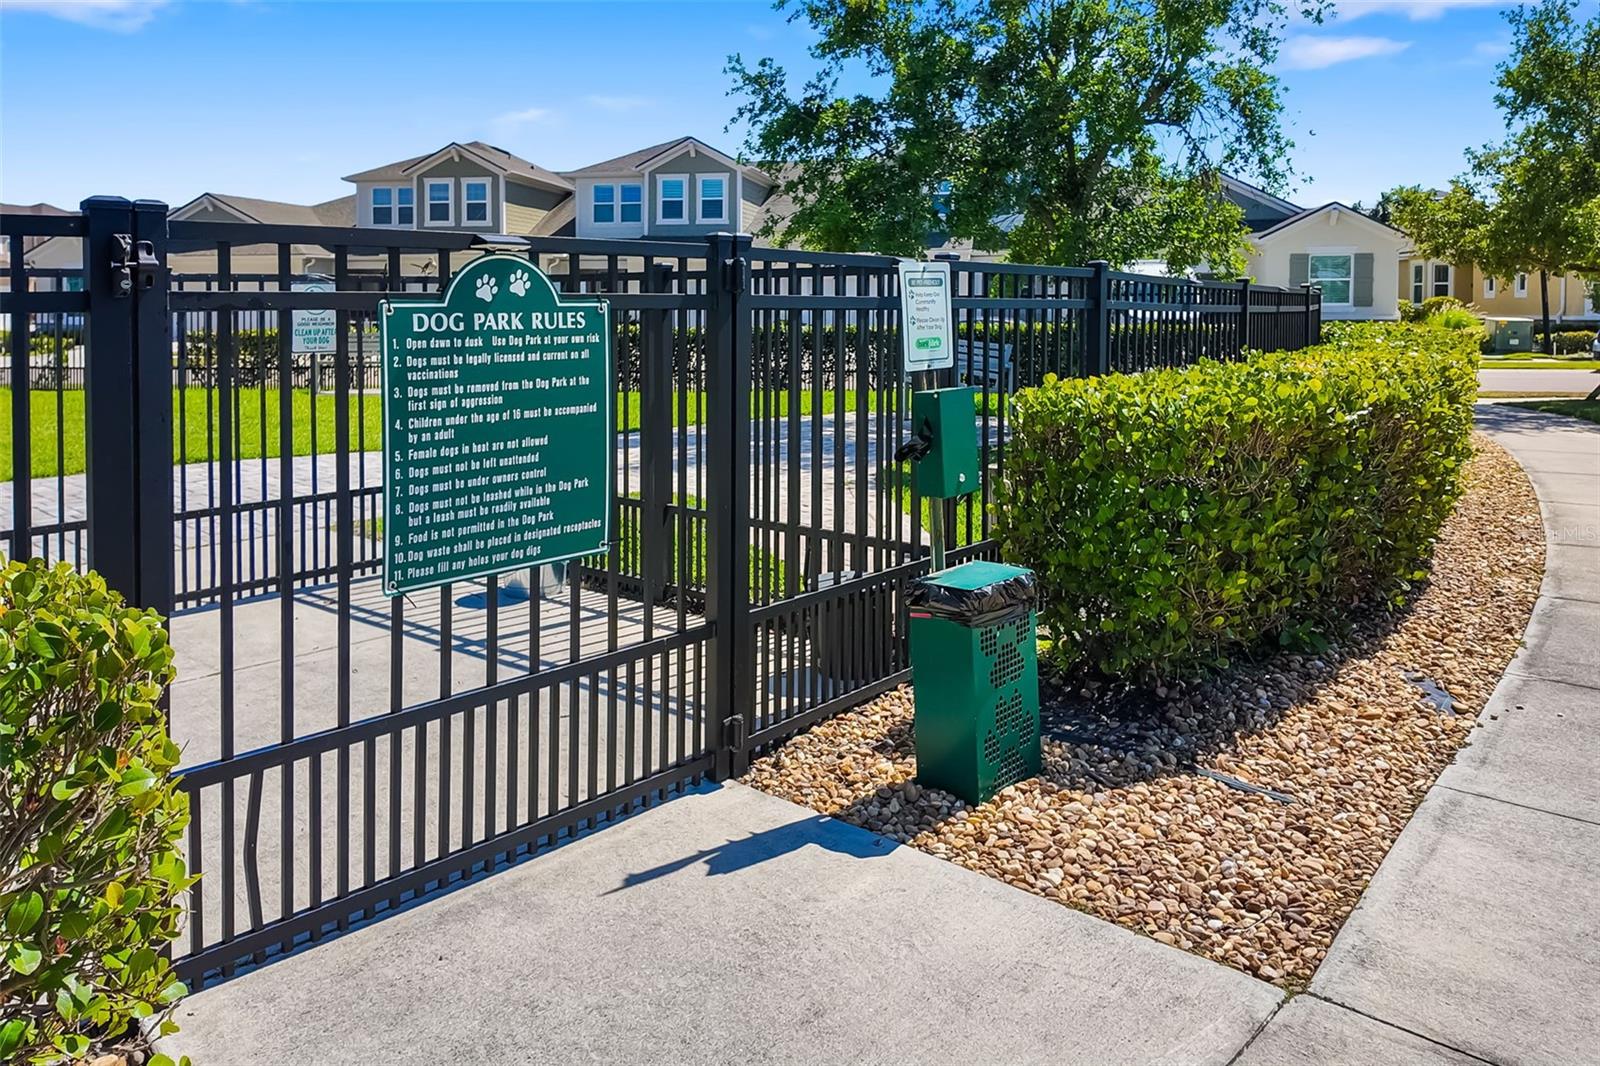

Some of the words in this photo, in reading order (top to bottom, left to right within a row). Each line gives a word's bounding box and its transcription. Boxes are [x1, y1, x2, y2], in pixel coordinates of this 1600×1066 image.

[322, 328, 336, 336] AFTE
[412, 312, 465, 332] DOG
[473, 312, 524, 330] PARK
[532, 312, 586, 329] RULES
[393, 338, 399, 350] 1.
[406, 338, 427, 350] Open
[430, 338, 450, 349] dawn
[454, 337, 462, 348] to
[465, 336, 483, 347] dusk
[492, 336, 506, 346] Use
[509, 335, 522, 347] Dog
[525, 334, 541, 345] Park
[544, 334, 552, 344] at
[553, 335, 568, 345] your
[571, 335, 584, 343] own
[587, 333, 600, 343] risk
[393, 356, 401, 367] 2.
[407, 356, 427, 368] Dogs
[430, 355, 450, 366] must
[454, 354, 463, 365] be
[466, 353, 491, 365] legally
[494, 352, 525, 363] licensed
[528, 351, 540, 361] and
[543, 350, 568, 360] current
[571, 351, 578, 359] on
[581, 349, 589, 359] all
[394, 388, 402, 398] 3.
[407, 386, 428, 398] Dogs
[432, 385, 451, 396] must
[454, 383, 464, 394] be
[467, 381, 499, 392] removed
[502, 380, 519, 391] from
[522, 379, 533, 390] the
[536, 378, 549, 390] Dog
[552, 377, 567, 387] Park
[570, 376, 576, 386] at
[579, 376, 589, 385] the
[408, 368, 459, 380] vaccinations
[394, 420, 403, 430] 4.
[408, 417, 442, 429] Children
[446, 414, 468, 425] under
[471, 412, 483, 423] the
[487, 412, 499, 423] age
[502, 410, 510, 420] of
[513, 409, 521, 420] 16
[524, 408, 540, 418] must
[544, 406, 552, 417] be
[555, 402, 597, 415] accompanied
[408, 400, 426, 411] first
[430, 399, 446, 411] sign
[450, 397, 458, 408] of
[462, 394, 503, 408] aggression
[394, 451, 403, 462] 5.
[408, 447, 437, 460] Female
[440, 446, 459, 457] dogs
[462, 444, 470, 454] in
[472, 442, 489, 453] heat
[492, 442, 504, 451] are
[507, 438, 519, 449] not
[521, 435, 548, 448] allowed
[408, 432, 417, 444] by
[422, 432, 430, 441] an
[434, 429, 455, 440] adult
[395, 468, 403, 480] 6.
[409, 466, 428, 478] Dogs
[432, 463, 452, 475] must
[455, 461, 468, 472] not
[471, 460, 480, 470] be
[483, 458, 496, 468] left
[499, 452, 539, 467] unattended
[395, 486, 403, 497] 7.
[409, 484, 428, 496] Dogs
[432, 480, 452, 492] must
[455, 478, 464, 489] be
[468, 475, 489, 487] under
[492, 471, 518, 484] owners
[521, 467, 547, 480] control
[395, 504, 403, 515] 8.
[409, 502, 429, 514] Dogs
[432, 498, 452, 510] must
[455, 496, 468, 507] not
[471, 494, 480, 505] be
[483, 489, 512, 500] leashed
[514, 486, 533, 498] while
[536, 484, 542, 494] in
[545, 482, 556, 493] the
[559, 480, 572, 492] Dog
[574, 477, 589, 488] Park
[408, 516, 422, 527] but
[425, 515, 430, 524] a
[433, 510, 454, 523] leash
[458, 507, 476, 519] must
[480, 505, 488, 516] be
[492, 501, 517, 514] readily
[520, 496, 550, 509] available
[394, 552, 406, 564] 10.
[408, 550, 424, 562] Dog
[427, 546, 450, 558] waste
[454, 540, 472, 554] shall
[476, 539, 484, 550] be
[488, 534, 512, 549] placed
[514, 532, 521, 542] in
[524, 524, 561, 540] designated
[563, 518, 601, 533] receptacles
[395, 536, 403, 546] 9.
[408, 530, 428, 544] Food
[431, 529, 438, 540] is
[442, 527, 455, 539] not
[458, 520, 494, 538] permitted
[498, 518, 505, 529] in
[508, 516, 519, 528] the
[522, 514, 536, 525] Dog
[538, 510, 554, 522] Park
[394, 570, 404, 581] 11.
[408, 565, 434, 579] Please
[438, 560, 449, 574] fill
[452, 560, 465, 570] any
[468, 556, 489, 567] holes
[492, 550, 509, 564] your
[511, 548, 524, 560] dog
[526, 545, 541, 556] digs
